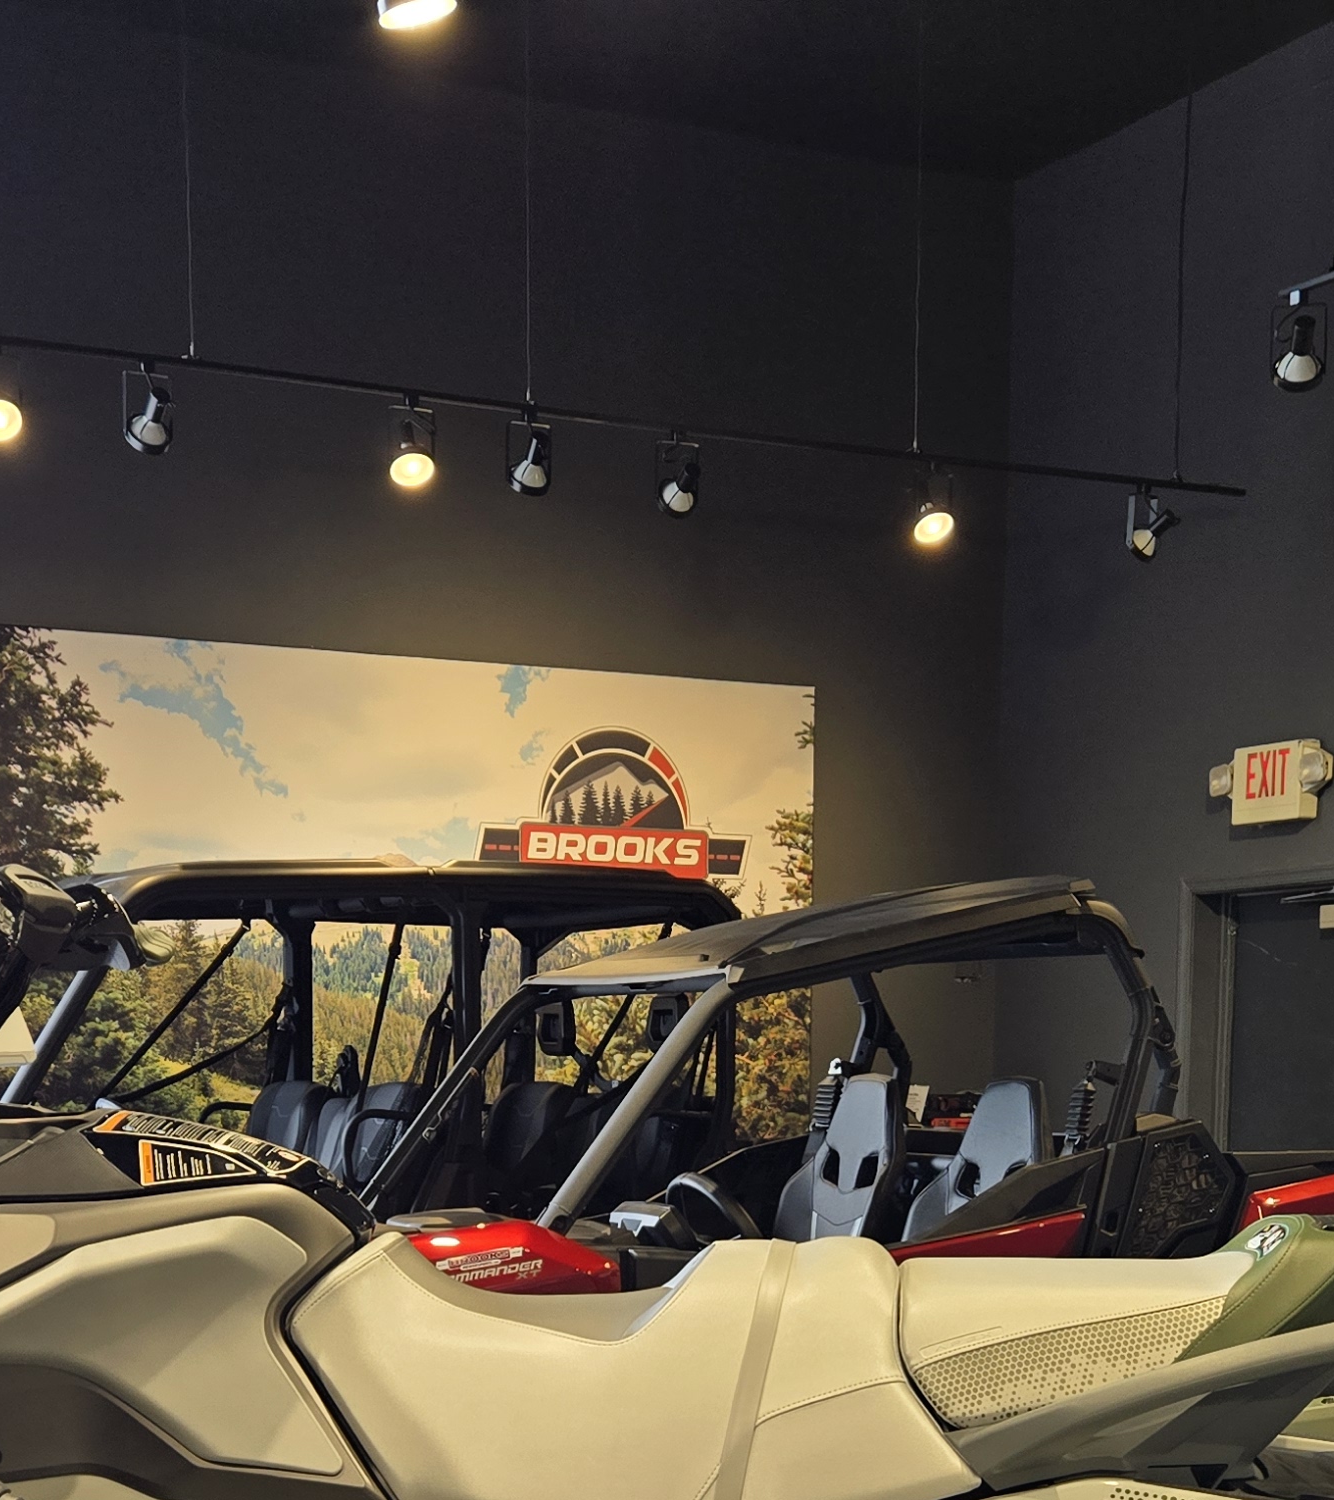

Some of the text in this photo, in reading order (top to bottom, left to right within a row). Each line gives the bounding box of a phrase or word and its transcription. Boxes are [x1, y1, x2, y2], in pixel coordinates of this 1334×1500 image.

[1246, 748, 1290, 800] EXIT
[527, 831, 702, 866] BROOKS
[451, 1259, 543, 1282] MMANDER
